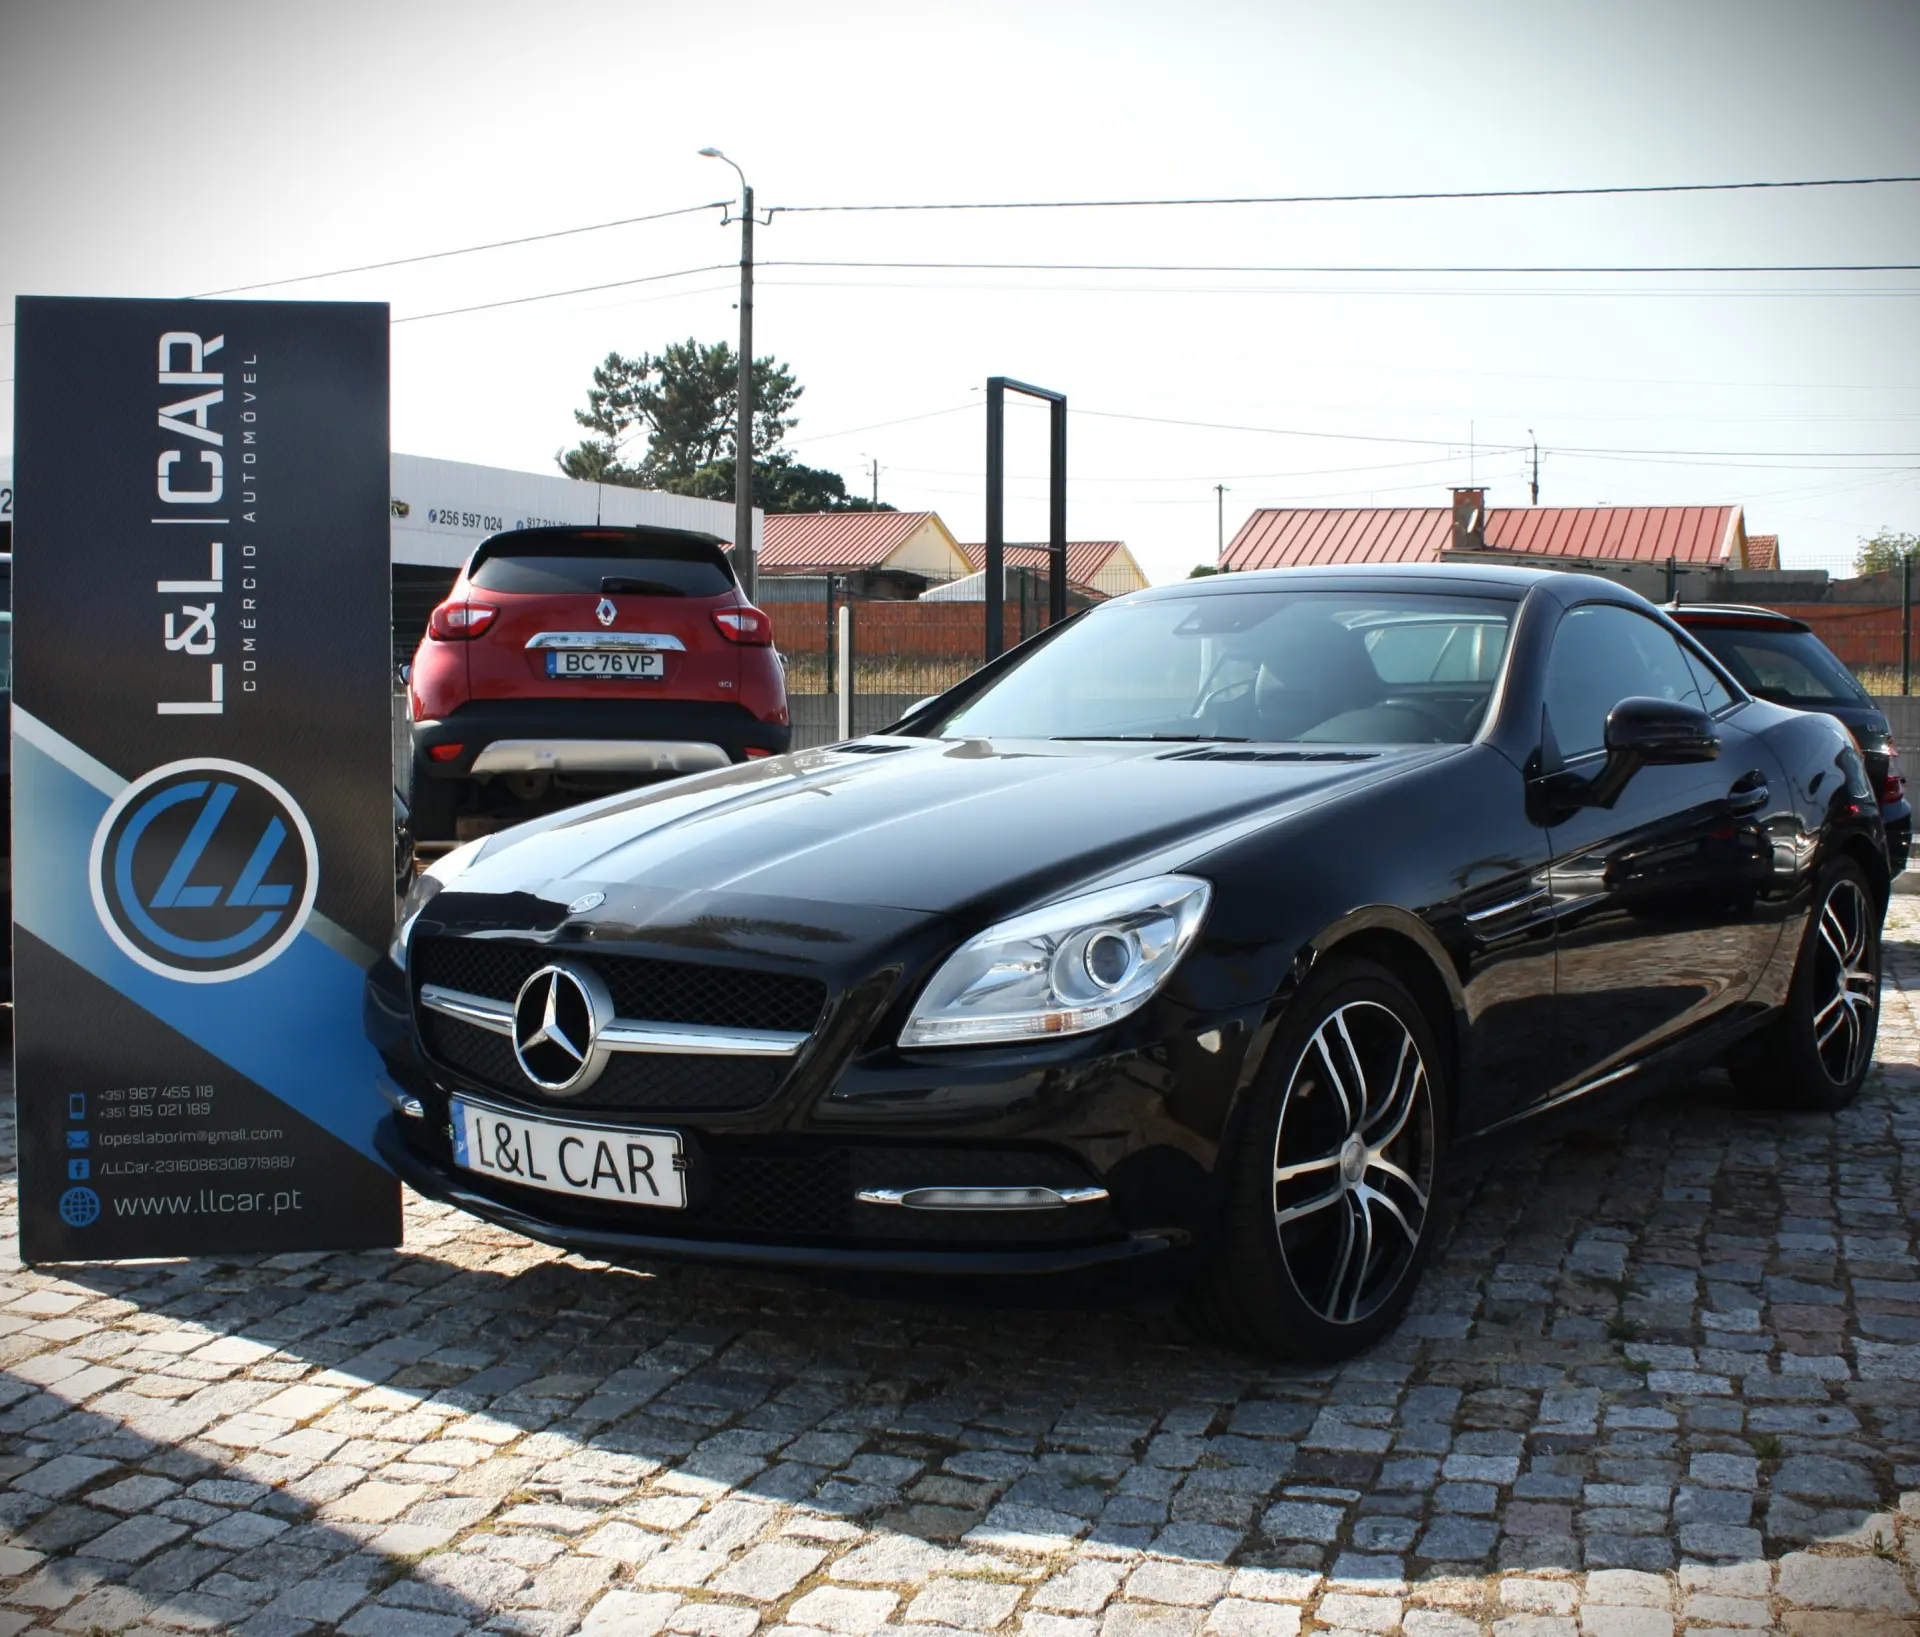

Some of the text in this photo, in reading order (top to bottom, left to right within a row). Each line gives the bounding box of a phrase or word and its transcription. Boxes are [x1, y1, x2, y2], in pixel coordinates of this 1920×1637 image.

[239, 353, 257, 692] COMÉRCIO AUTOMÓVEL
[439, 509, 503, 531] 256 597 024
[98, 1085, 214, 1101] +351 967 455 118
[100, 1102, 211, 1118] +351 915 021 189
[99, 1128, 283, 1147] lopeslaborim@gmail.com
[475, 1117, 660, 1197] L&L CAR
[113, 1188, 303, 1216] www.llcar.pt
